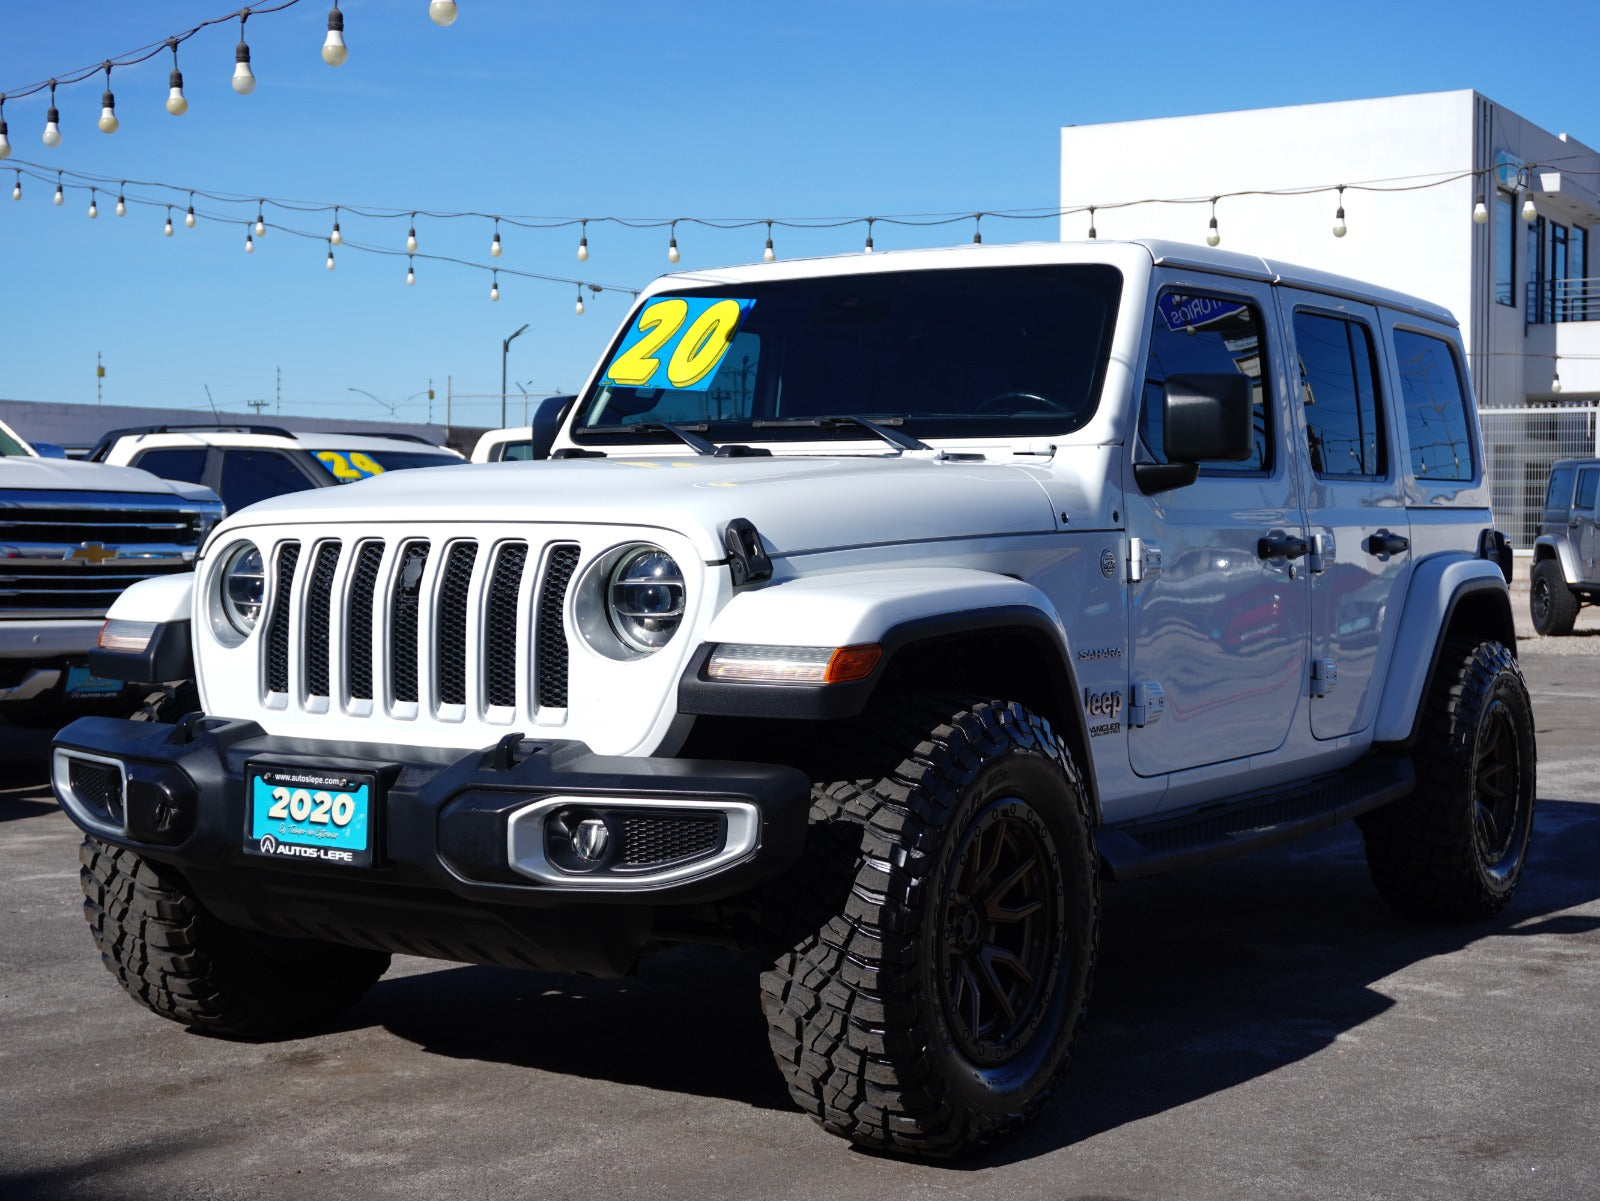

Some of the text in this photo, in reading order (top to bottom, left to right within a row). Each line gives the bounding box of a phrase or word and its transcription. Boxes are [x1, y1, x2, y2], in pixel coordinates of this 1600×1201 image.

[607, 299, 741, 388] 20
[1078, 648, 1121, 660] SAHARA
[1085, 687, 1122, 718] Jeep
[1090, 722, 1120, 733] ANGLER
[275, 773, 340, 785] www.autoslepe.com
[268, 787, 355, 826] 2020
